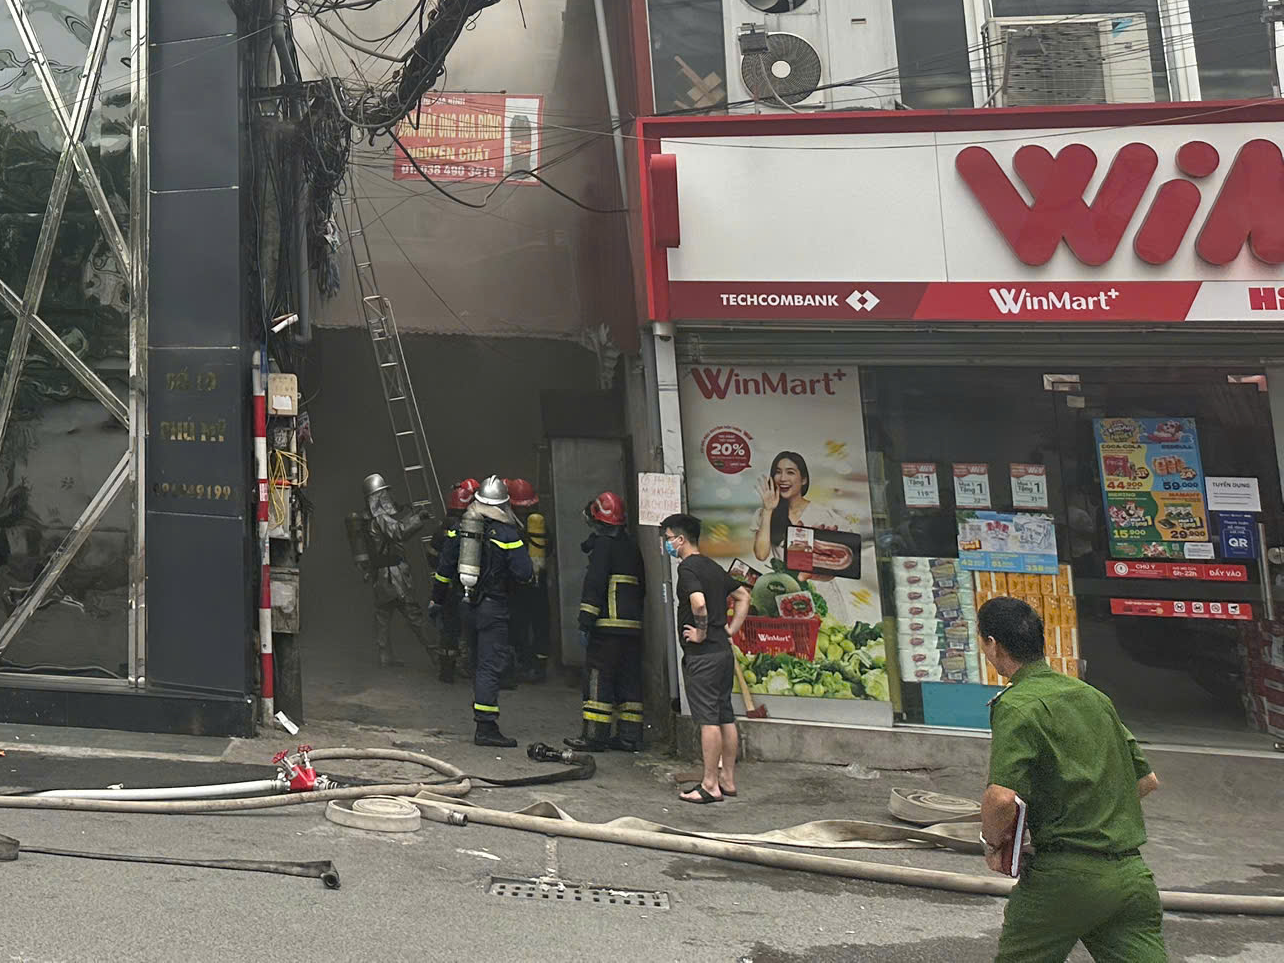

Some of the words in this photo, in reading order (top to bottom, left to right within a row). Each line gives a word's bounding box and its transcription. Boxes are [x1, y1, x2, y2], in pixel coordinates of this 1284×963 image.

[720, 293, 839, 307] TECHCOMBANK
[711, 443, 746, 456] 20%
[1228, 537, 1248, 547] QR
